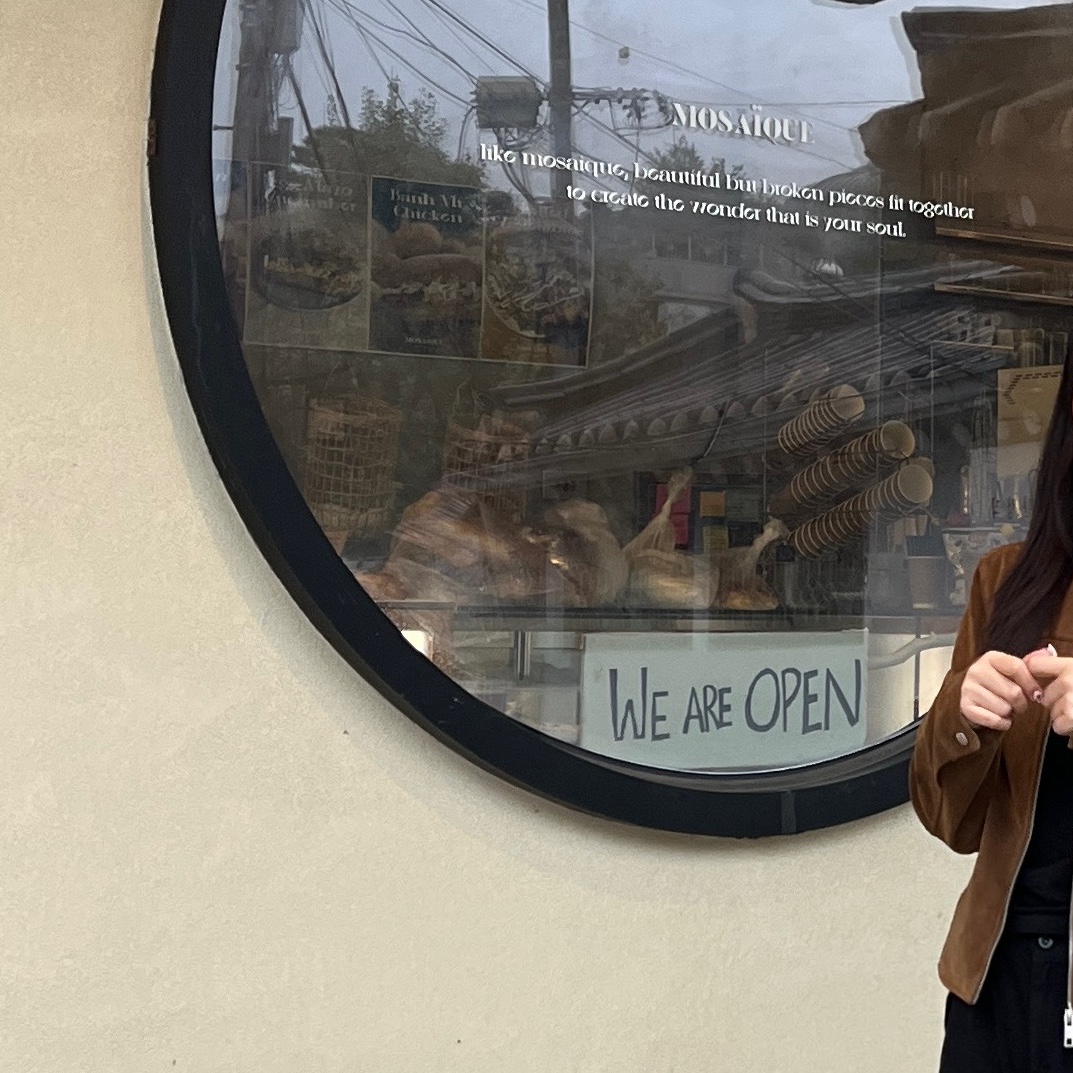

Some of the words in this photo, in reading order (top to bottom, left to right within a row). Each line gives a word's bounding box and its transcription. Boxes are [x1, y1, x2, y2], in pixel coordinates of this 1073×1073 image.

[393, 204, 463, 224] Chicken
[480, 143, 516, 164] like
[522, 152, 628, 181] mosaique,
[633, 162, 720, 189] beautiful
[726, 174, 757, 194] but
[763, 178, 824, 201] broken
[829, 188, 884, 209] pieces
[889, 194, 904, 211] fit
[909, 198, 974, 220] together
[566, 184, 586, 200] to
[591, 190, 649, 208] create
[655, 193, 685, 212] the
[690, 201, 761, 221] wonder
[766, 206, 799, 226] that
[805, 211, 819, 227] is
[823, 215, 862, 232] your
[866, 221, 906, 238] soul.
[609, 667, 670, 741] WE
[682, 684, 732, 734] ARE
[745, 659, 861, 735] OPEN
